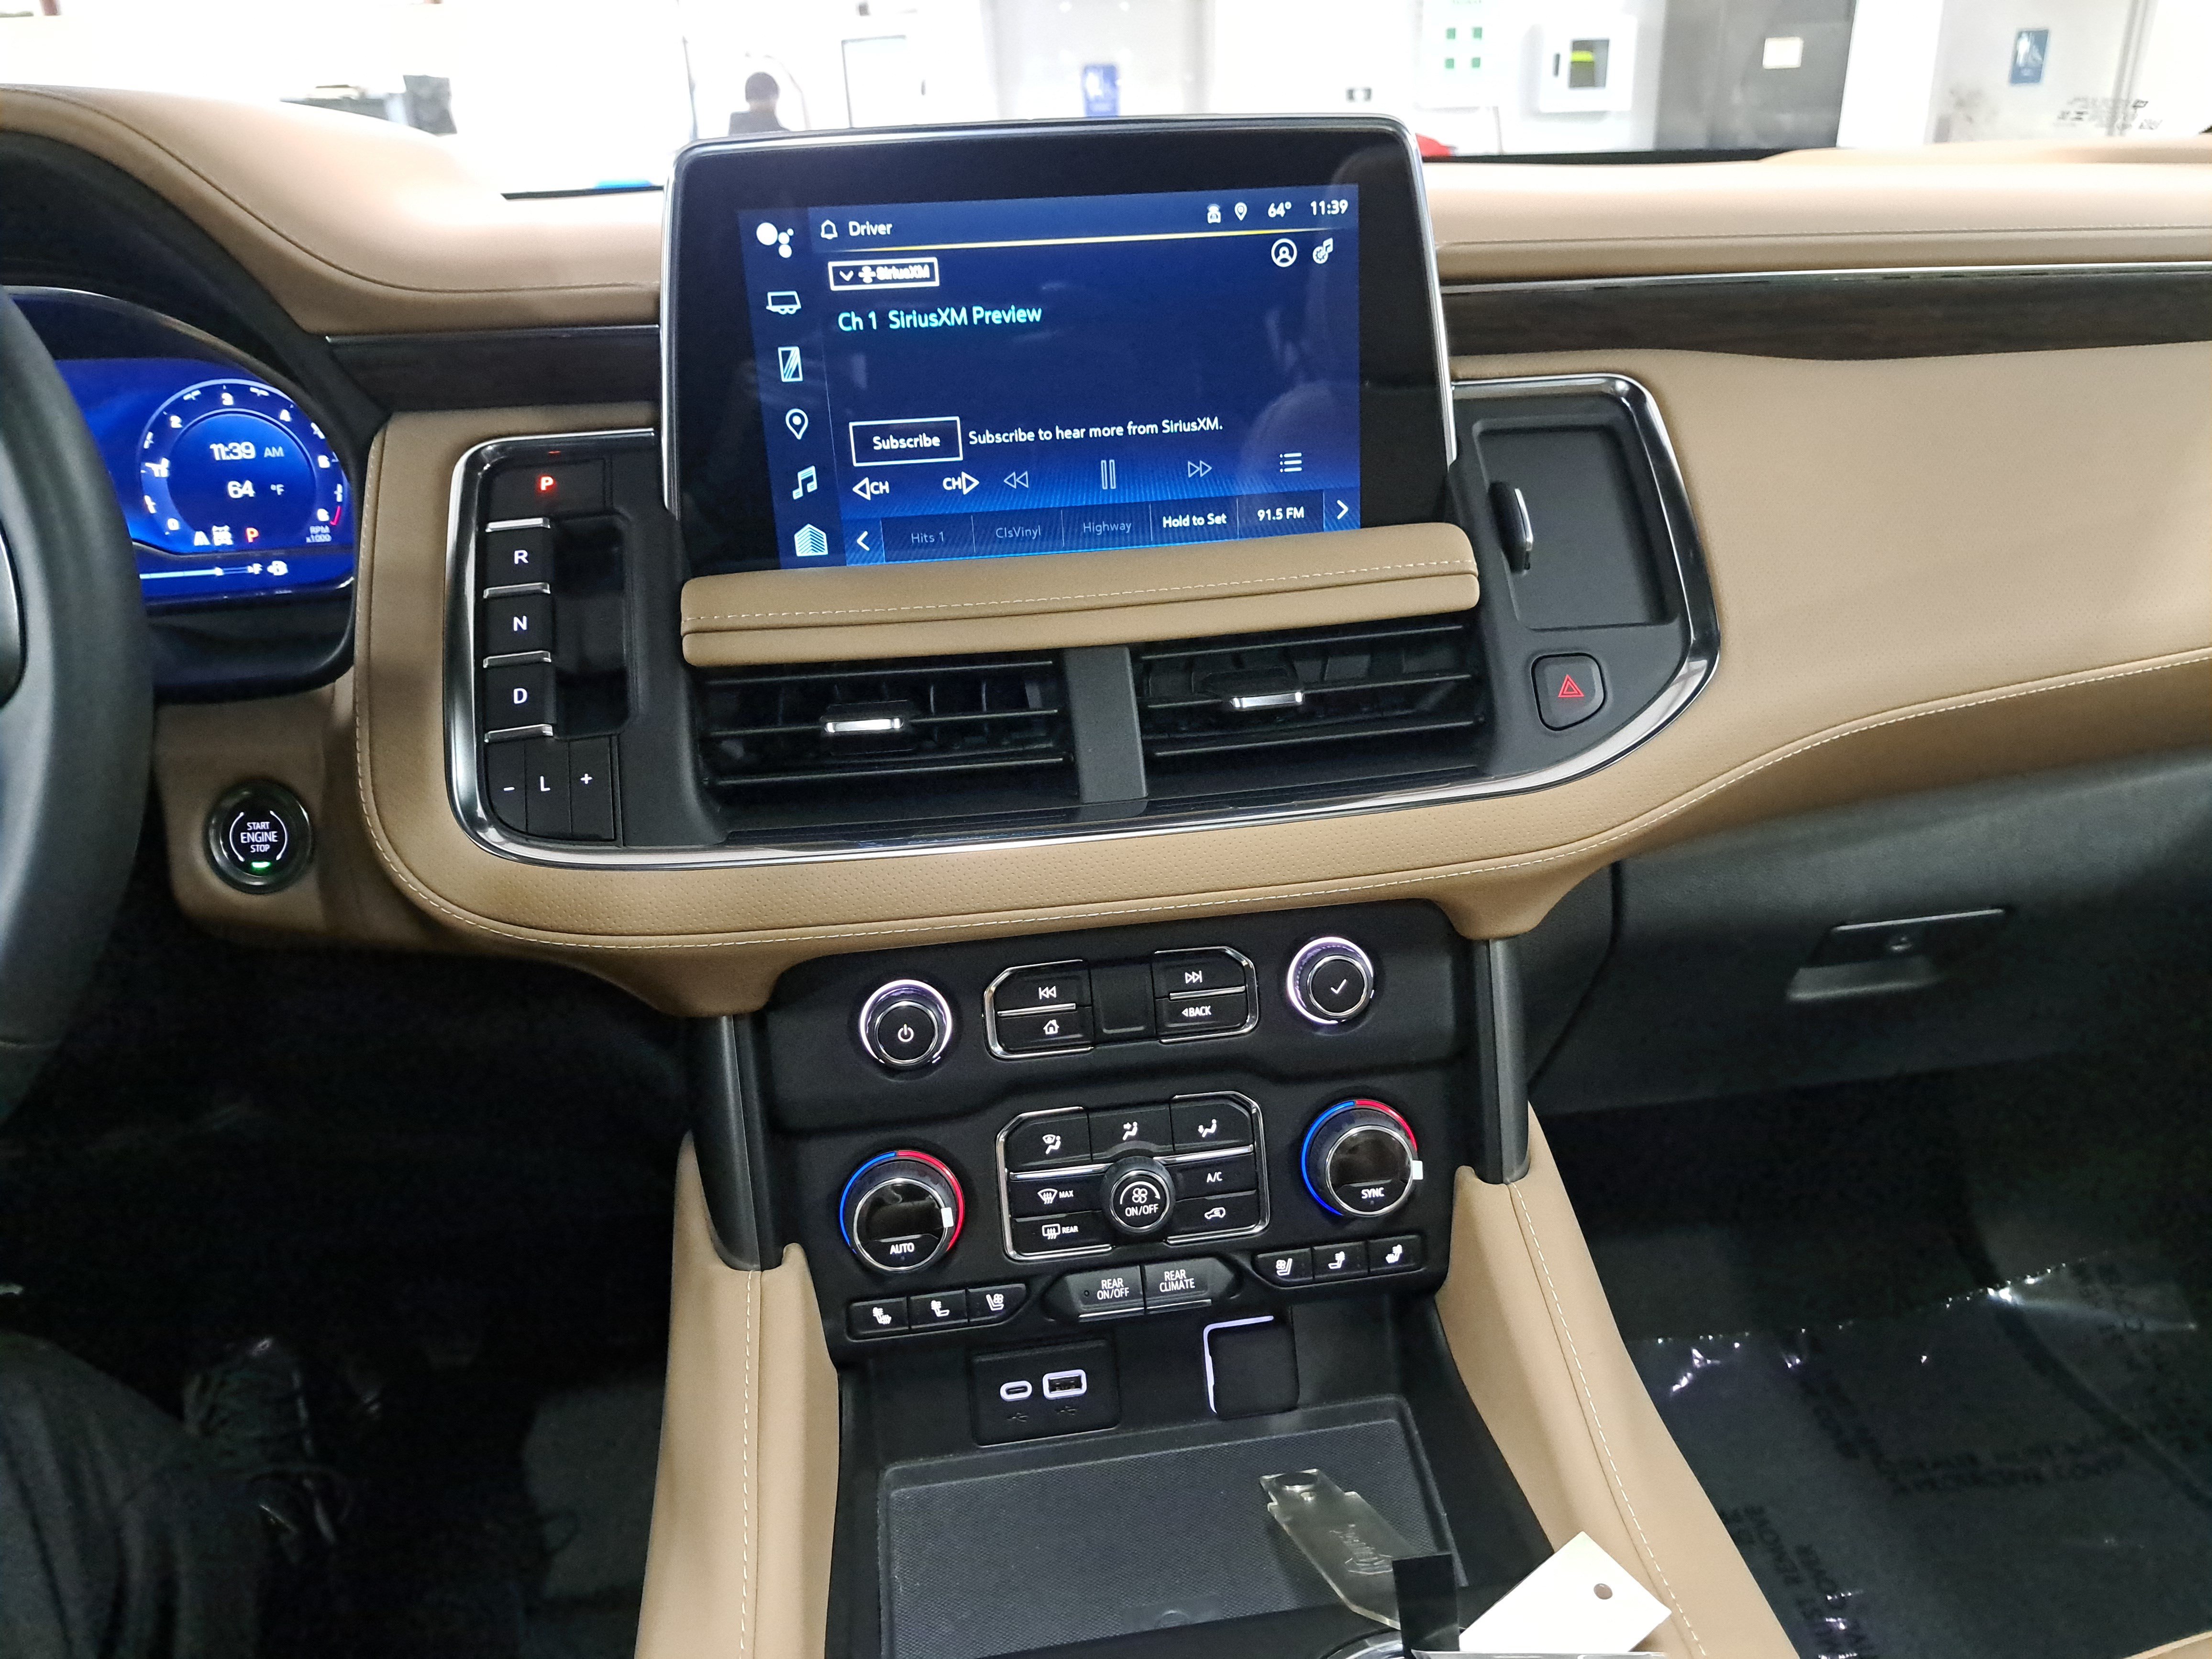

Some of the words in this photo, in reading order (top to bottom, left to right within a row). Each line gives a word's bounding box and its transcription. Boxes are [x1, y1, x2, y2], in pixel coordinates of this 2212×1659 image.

[1268, 201, 1292, 217] 64°
[1310, 199, 1349, 215] 11:39
[848, 221, 893, 236] Driver
[876, 265, 930, 280] SiriusXM
[838, 312, 863, 332] Ch
[869, 311, 877, 329] 1
[888, 307, 968, 330] SiriusXM
[972, 305, 1042, 324] Preview
[968, 428, 1035, 445] Subscribe
[1038, 429, 1052, 441] to
[1055, 425, 1084, 440] hear
[1089, 426, 1124, 438] more
[1127, 420, 1158, 436] from
[1161, 416, 1223, 433] SiriusXM.
[873, 433, 940, 451] Subscribe
[210, 442, 257, 461] 11:39
[264, 446, 285, 458] AM
[228, 480, 256, 498] 64
[540, 476, 554, 491] P
[870, 481, 890, 495] CH
[942, 476, 962, 491] CH
[1162, 515, 1190, 528] Hold
[1192, 515, 1205, 526] to
[1207, 513, 1227, 525] Set
[1257, 509, 1283, 521] 91.5
[1286, 506, 1305, 520] FM
[245, 527, 259, 542] P
[1083, 522, 1132, 536] Highway
[911, 532, 935, 544] Hits
[939, 531, 944, 542] 1
[514, 550, 529, 564] R
[513, 615, 527, 631] N
[513, 688, 528, 704] D
[540, 775, 551, 792] L
[246, 821, 270, 830] START
[240, 831, 278, 843] ENGINE
[250, 844, 270, 853] STOP
[1189, 1005, 1212, 1017] BACK
[1206, 1171, 1223, 1183] A/C
[1059, 1190, 1074, 1198] MAX
[1361, 1187, 1384, 1199] SYNC
[1125, 1204, 1159, 1217] ON/OFF
[1062, 1226, 1079, 1234] REAR
[890, 1242, 915, 1255] AUTO
[1164, 1269, 1186, 1282] REAR
[1101, 1278, 1124, 1290] REAR
[1159, 1278, 1195, 1292] CLIMATE
[1096, 1287, 1129, 1300] ON/OFF
